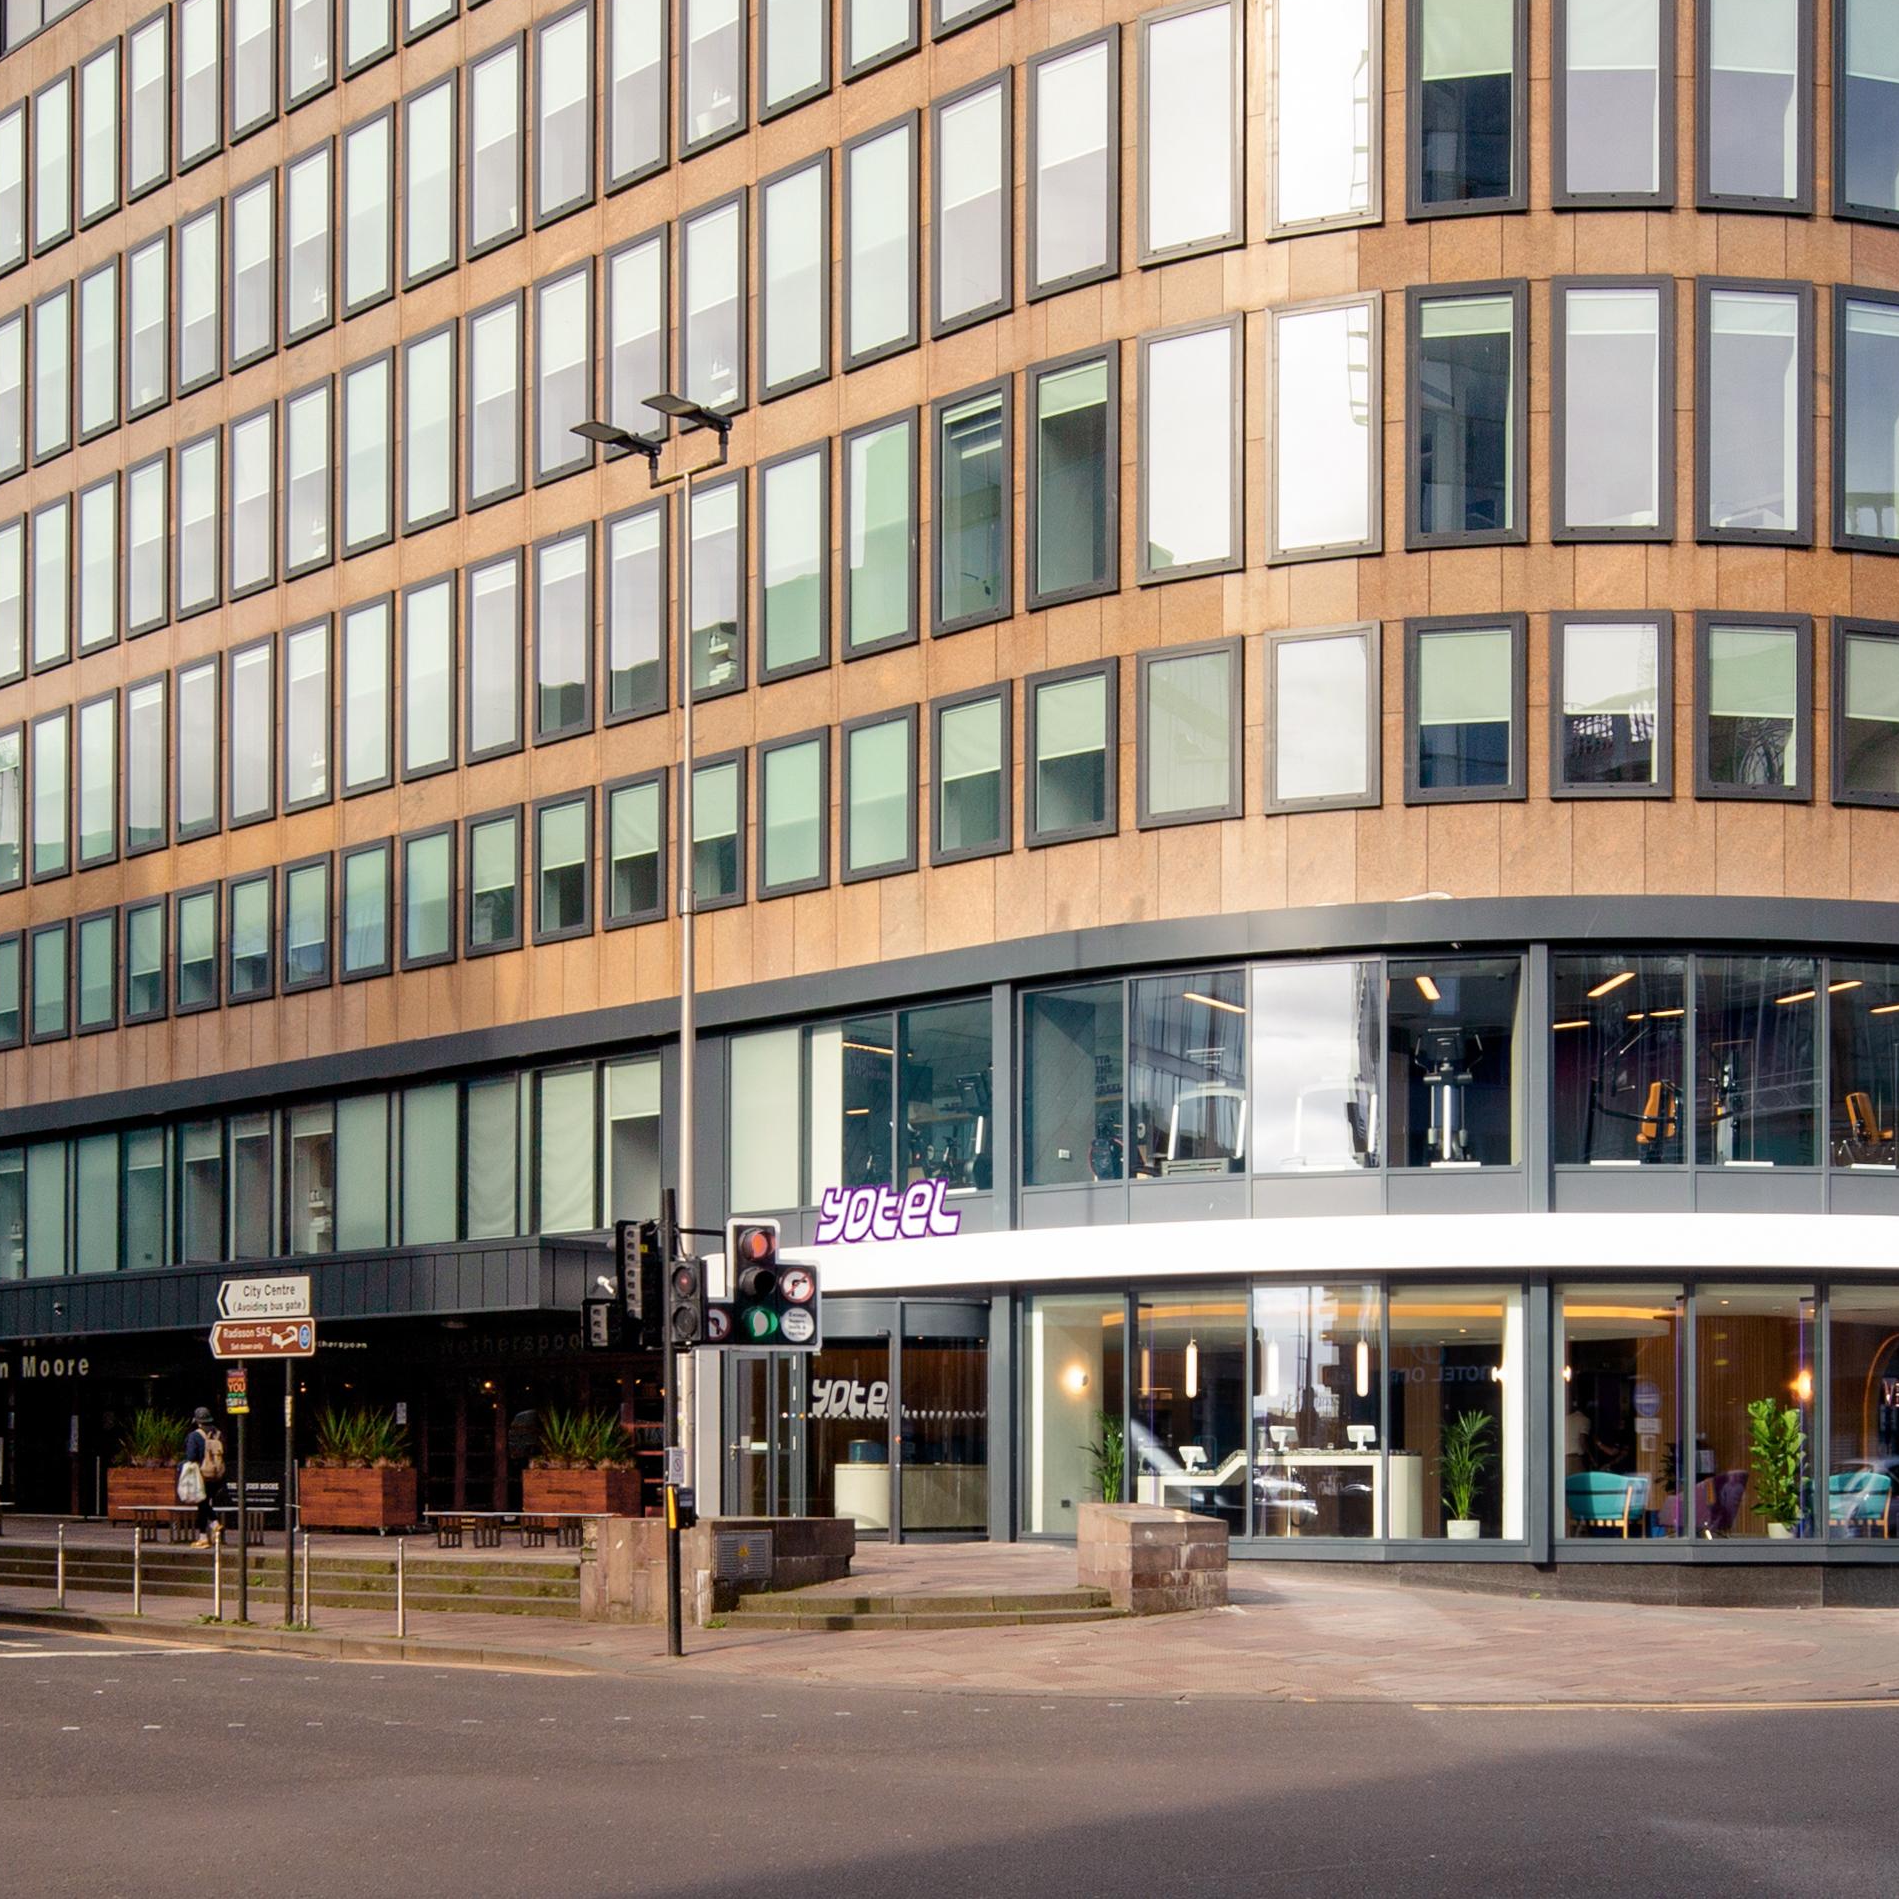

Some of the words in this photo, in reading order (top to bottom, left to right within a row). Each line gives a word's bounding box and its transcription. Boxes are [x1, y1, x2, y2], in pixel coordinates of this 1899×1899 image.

[242, 1285, 262, 1299] City
[264, 1284, 296, 1296] Centre
[233, 1302, 268, 1313] (Avoiding
[270, 1301, 284, 1311] bus
[285, 1298, 307, 1312] gate)
[222, 1327, 255, 1339] Radisson
[256, 1326, 272, 1338] SAS
[22, 1355, 89, 1378] Moore
